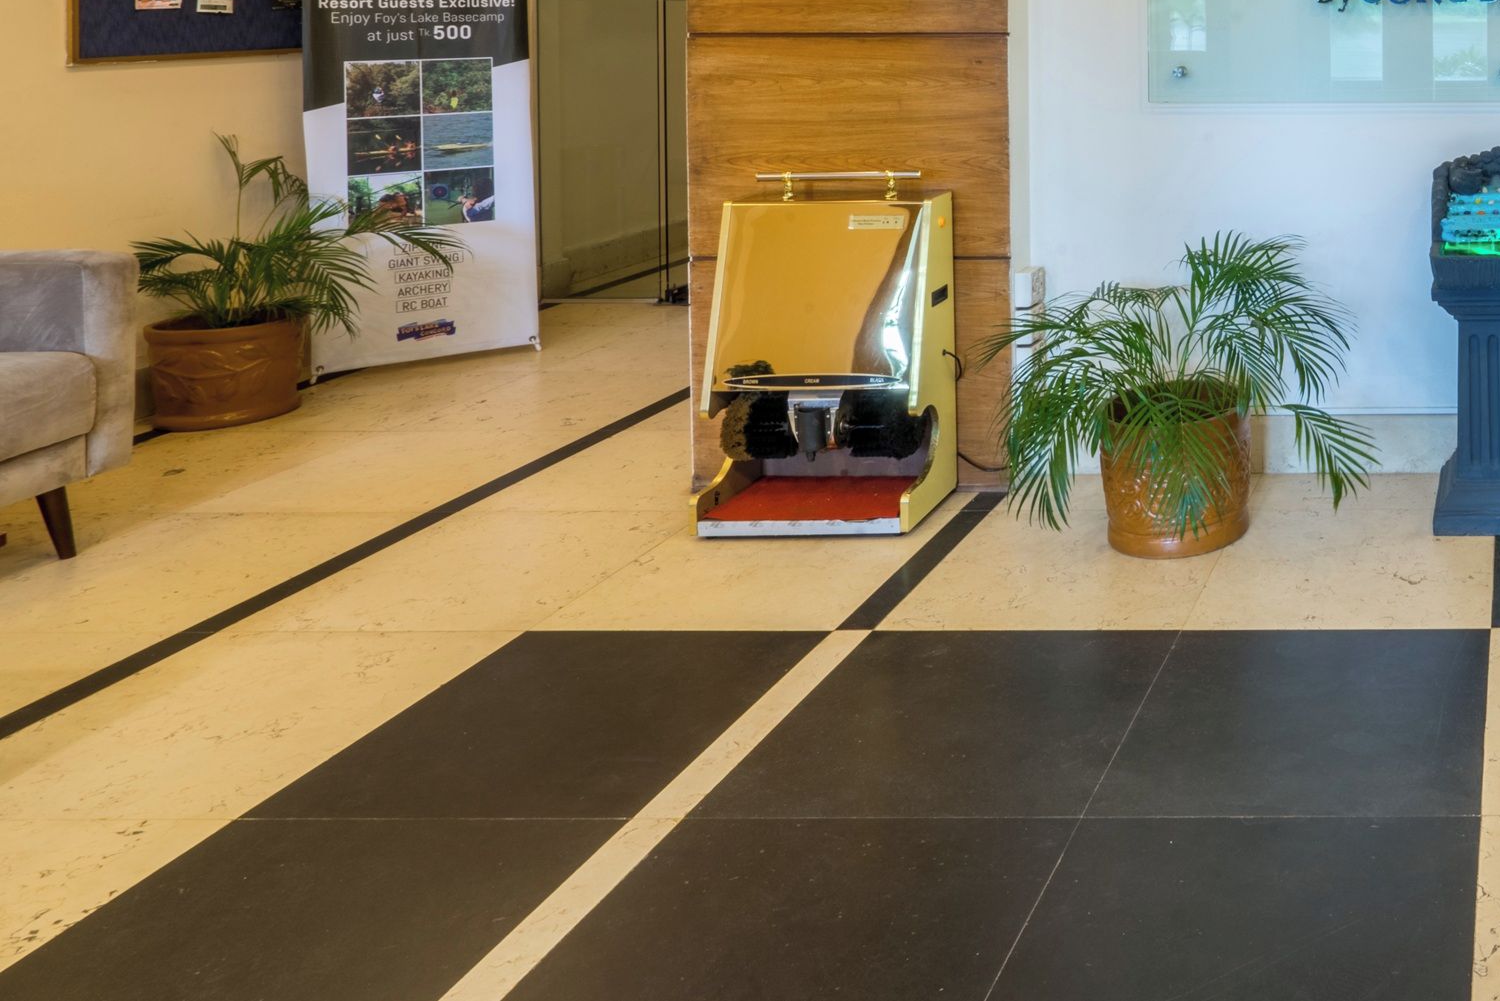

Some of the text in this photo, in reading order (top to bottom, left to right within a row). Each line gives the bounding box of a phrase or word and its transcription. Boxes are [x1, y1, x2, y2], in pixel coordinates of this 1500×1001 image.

[330, 11, 505, 26] Enjoy Foy's Lake Basecamp
[367, 31, 382, 41] at
[386, 29, 415, 44] just
[433, 25, 472, 40] 500
[388, 252, 460, 269] GIANT SWNG
[399, 269, 451, 282] KAYAKING
[398, 283, 449, 296] ARCHERY
[402, 297, 448, 311] RC BOAT
